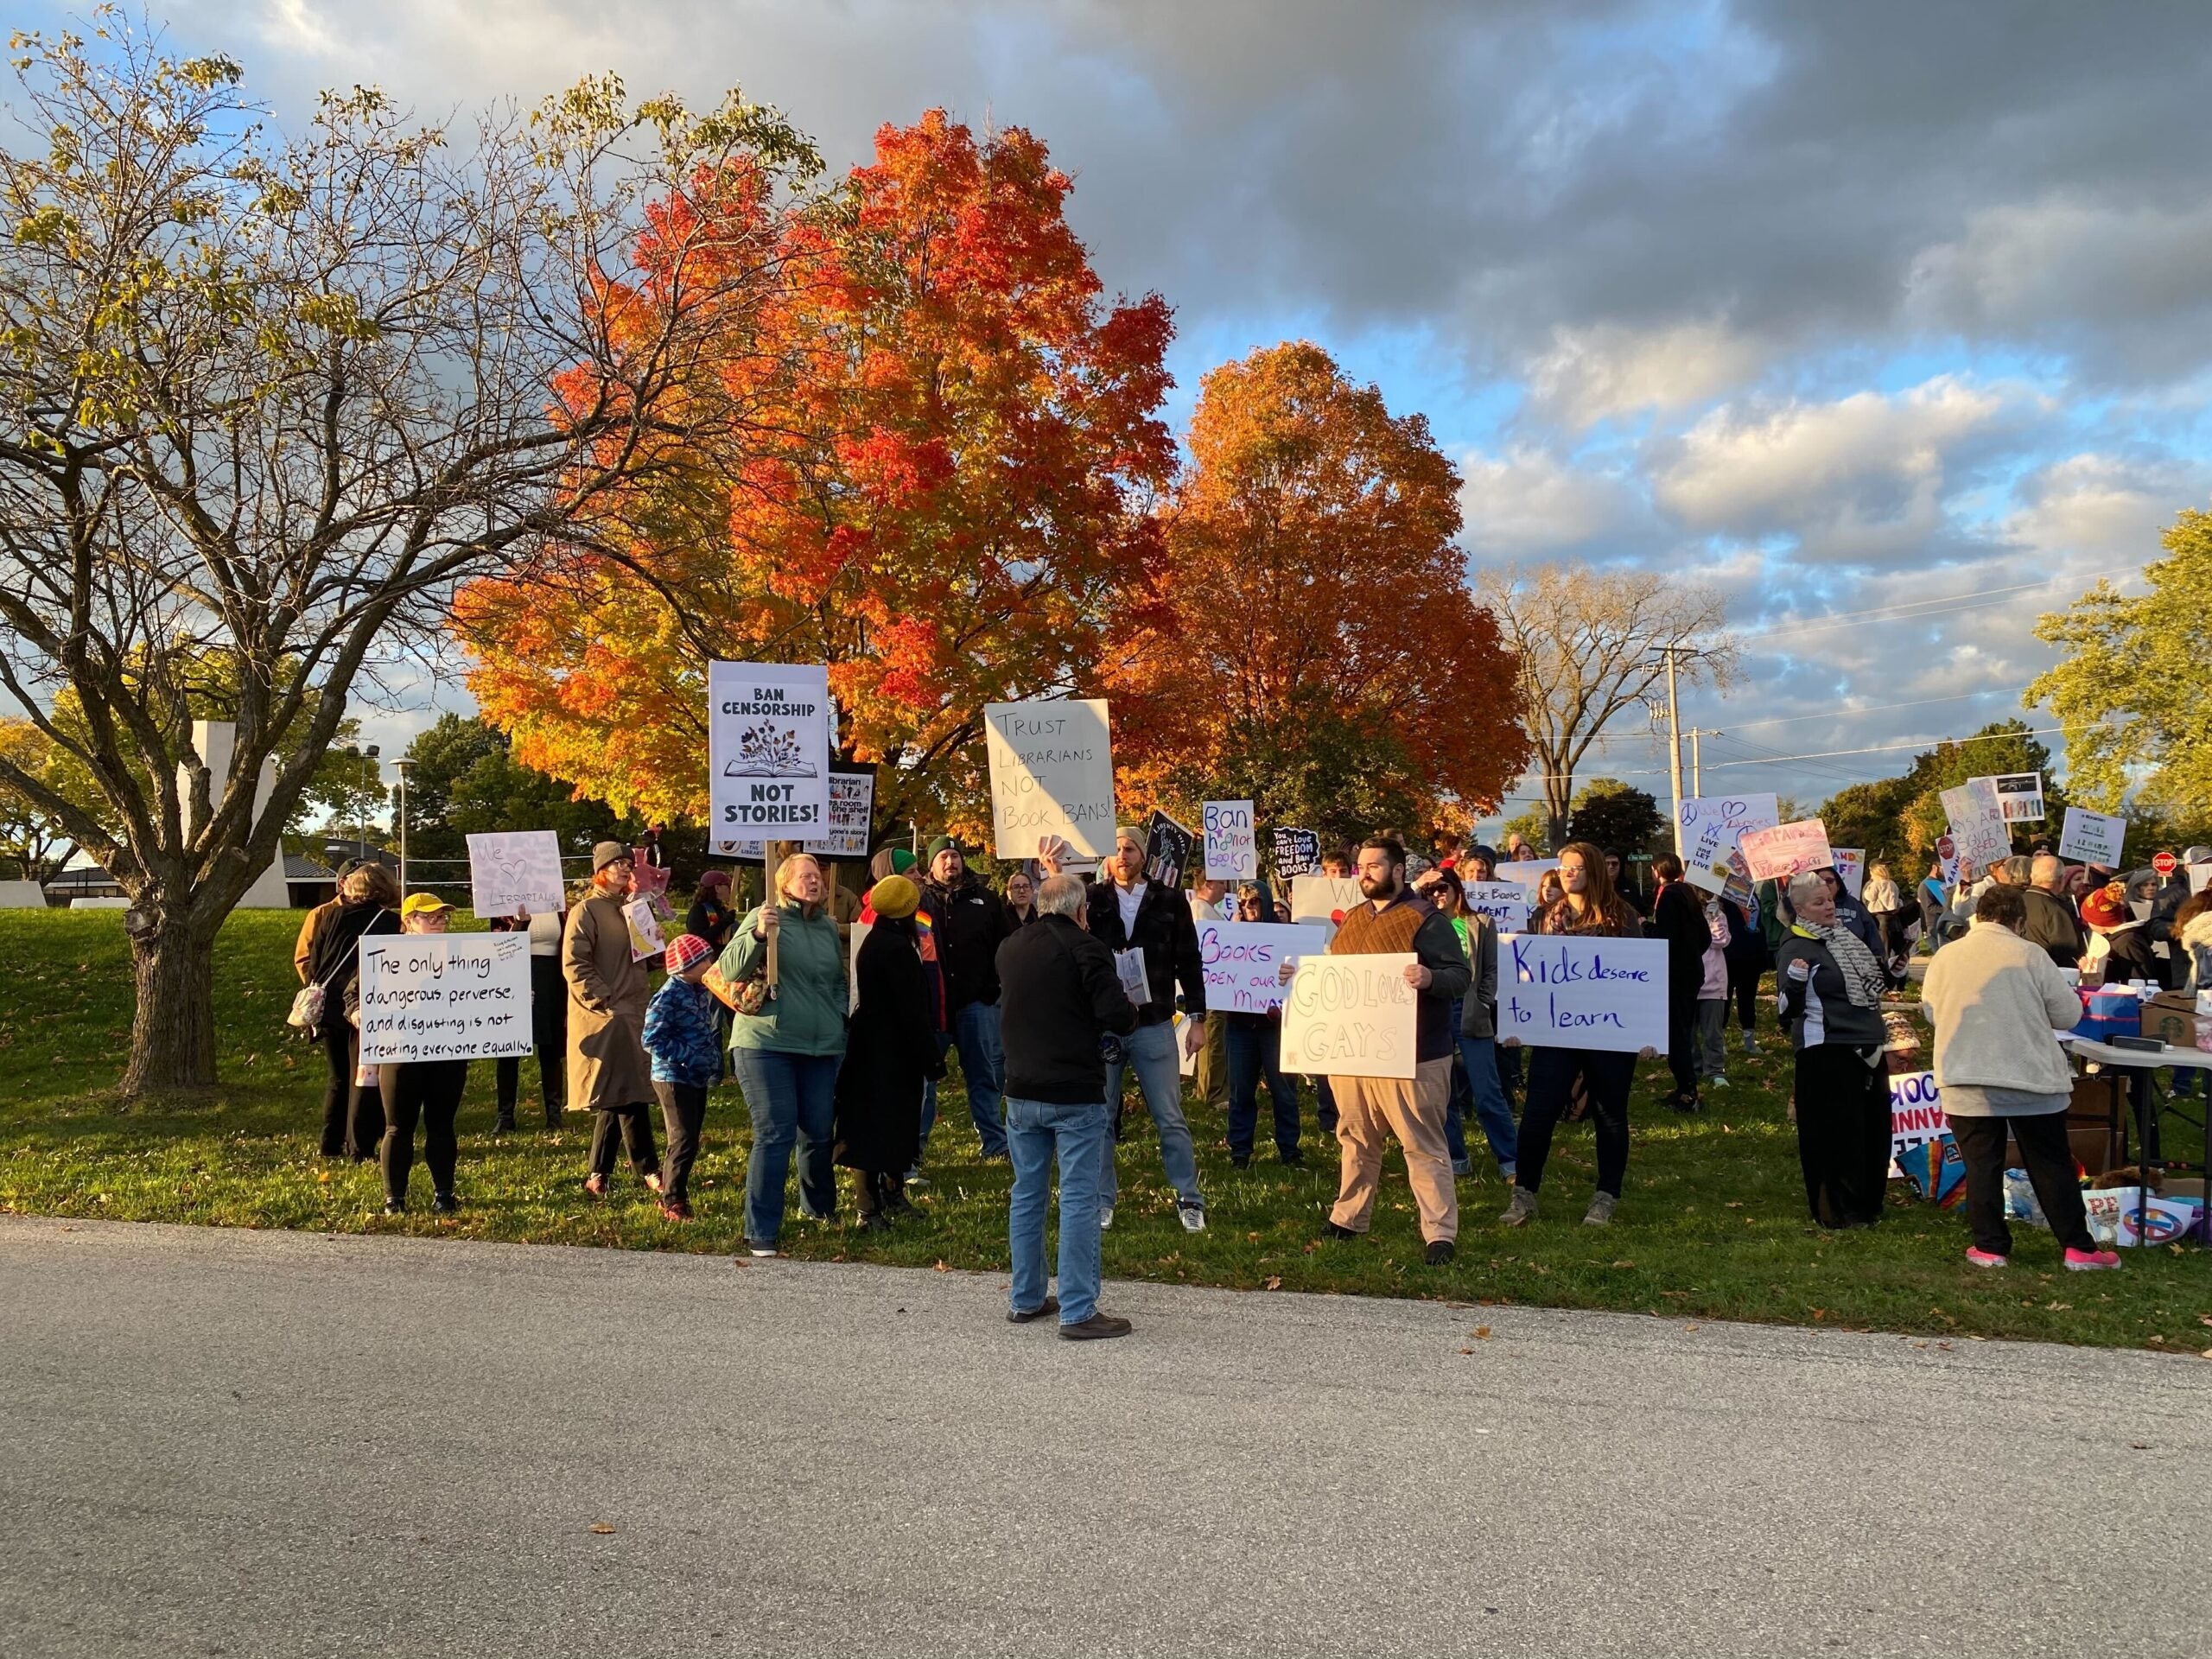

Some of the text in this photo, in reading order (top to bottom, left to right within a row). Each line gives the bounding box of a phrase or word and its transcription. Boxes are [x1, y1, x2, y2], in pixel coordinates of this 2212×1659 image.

[753, 688, 784, 701] BAN
[722, 702, 815, 716] CENSORSHIP
[995, 712, 1066, 736] TRUST
[1000, 748, 1093, 768] LIBRARIANS
[751, 784, 794, 802] NOT
[1001, 775, 1046, 796] NOT
[724, 804, 819, 823] STORIES!
[1003, 795, 1110, 830] BOOK BANS!
[1205, 806, 1248, 831] Ban
[1153, 823, 1177, 834] LIBERTY
[476, 838, 504, 861] We
[1275, 843, 1313, 856] FREEDOM
[1697, 846, 1711, 855] and
[1700, 836, 1719, 849] LIVE
[1693, 859, 1710, 871] LIVE
[1695, 851, 1711, 861] LET
[1832, 851, 1864, 863] ANDS
[2155, 858, 2175, 868] STOP
[1281, 862, 1308, 875] BOOKS
[1463, 889, 1489, 900] HESE
[367, 949, 491, 979] The only thing
[1513, 940, 1582, 984] Kids
[1250, 976, 1275, 988] OUR
[1292, 963, 1415, 1017] GOD LOVES
[365, 985, 515, 1009] dangerous, perverse,
[1509, 992, 1627, 1028] to learn
[366, 1013, 514, 1035] and disgusting is not
[364, 1039, 532, 1060] treating everyone equally.
[1303, 1022, 1397, 1062] GAYS
